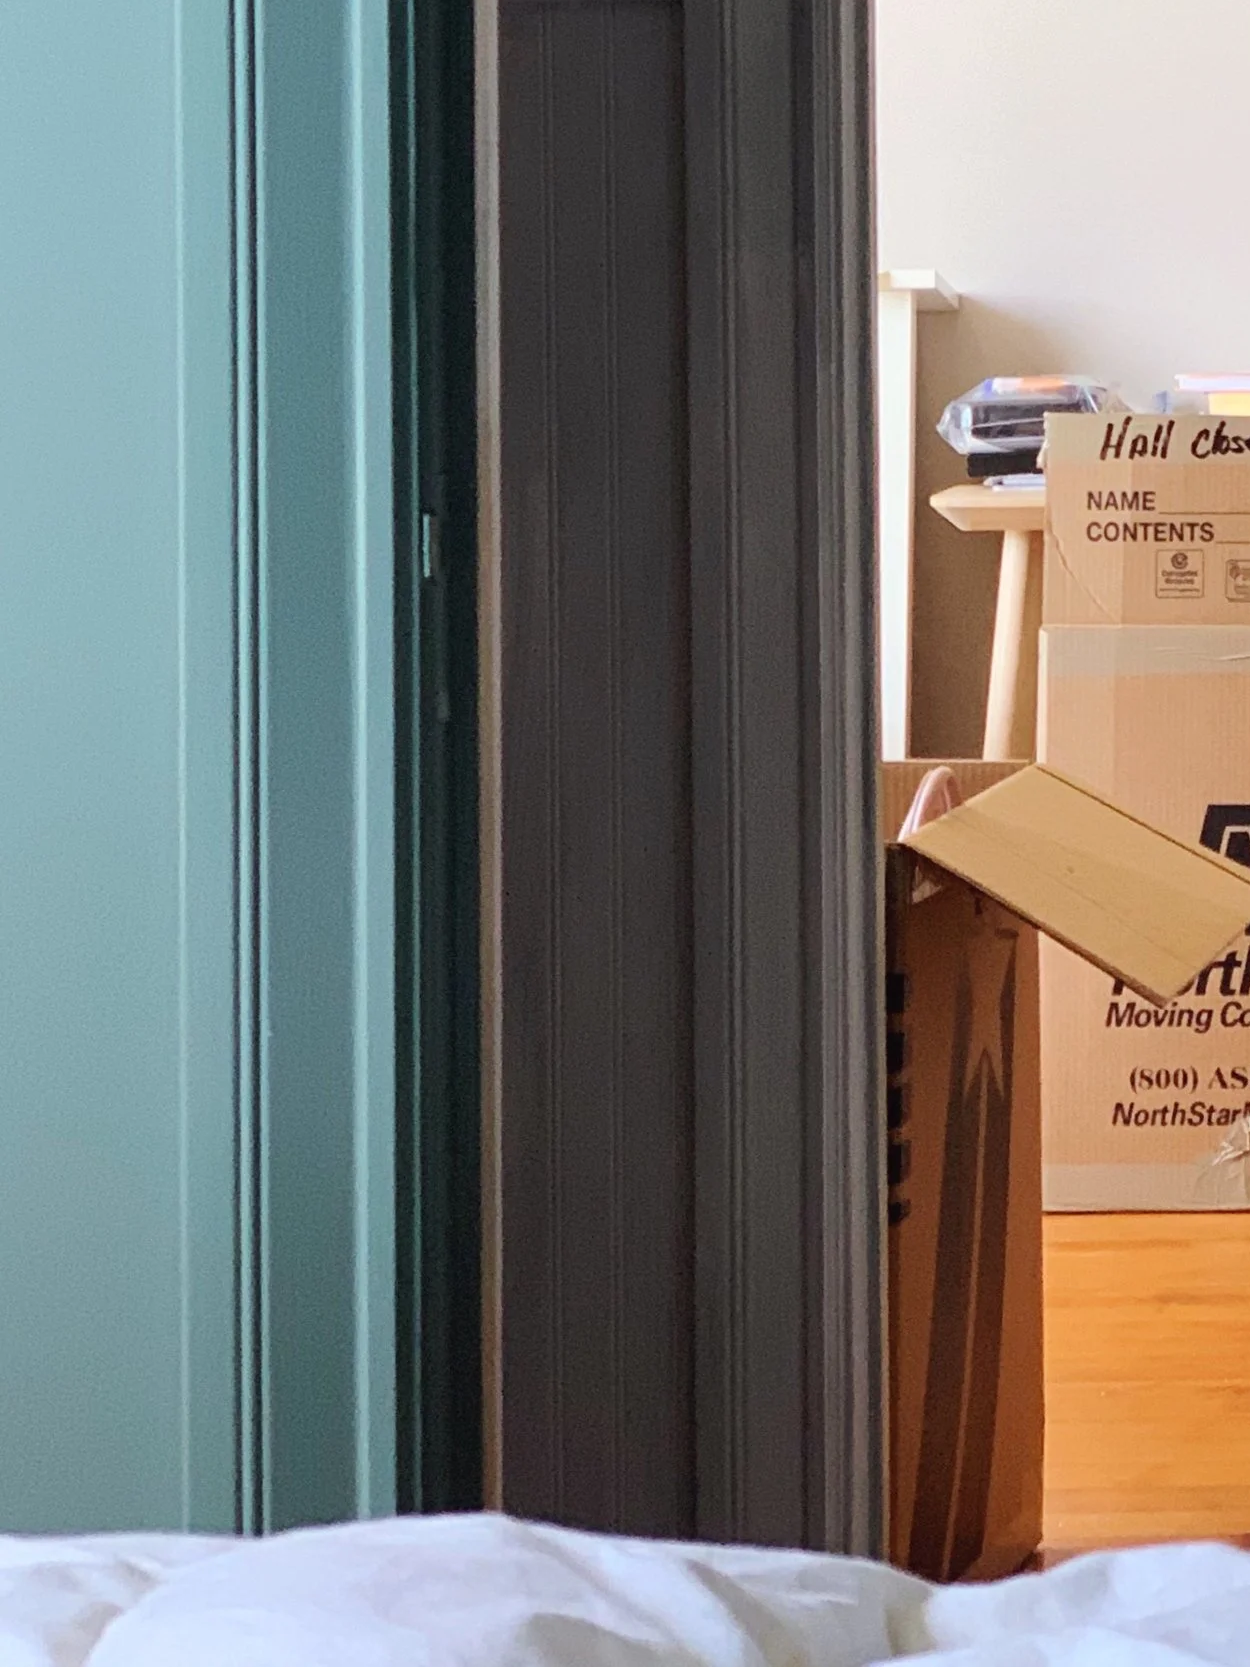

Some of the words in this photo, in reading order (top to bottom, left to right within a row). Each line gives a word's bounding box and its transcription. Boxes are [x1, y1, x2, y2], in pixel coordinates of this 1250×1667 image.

[1100, 416, 1175, 461] Hall
[1086, 491, 1156, 511] NAME
[1086, 522, 1215, 543] CONTENTS
[1105, 1001, 1213, 1034] Moving
[1129, 1066, 1199, 1094] (800)
